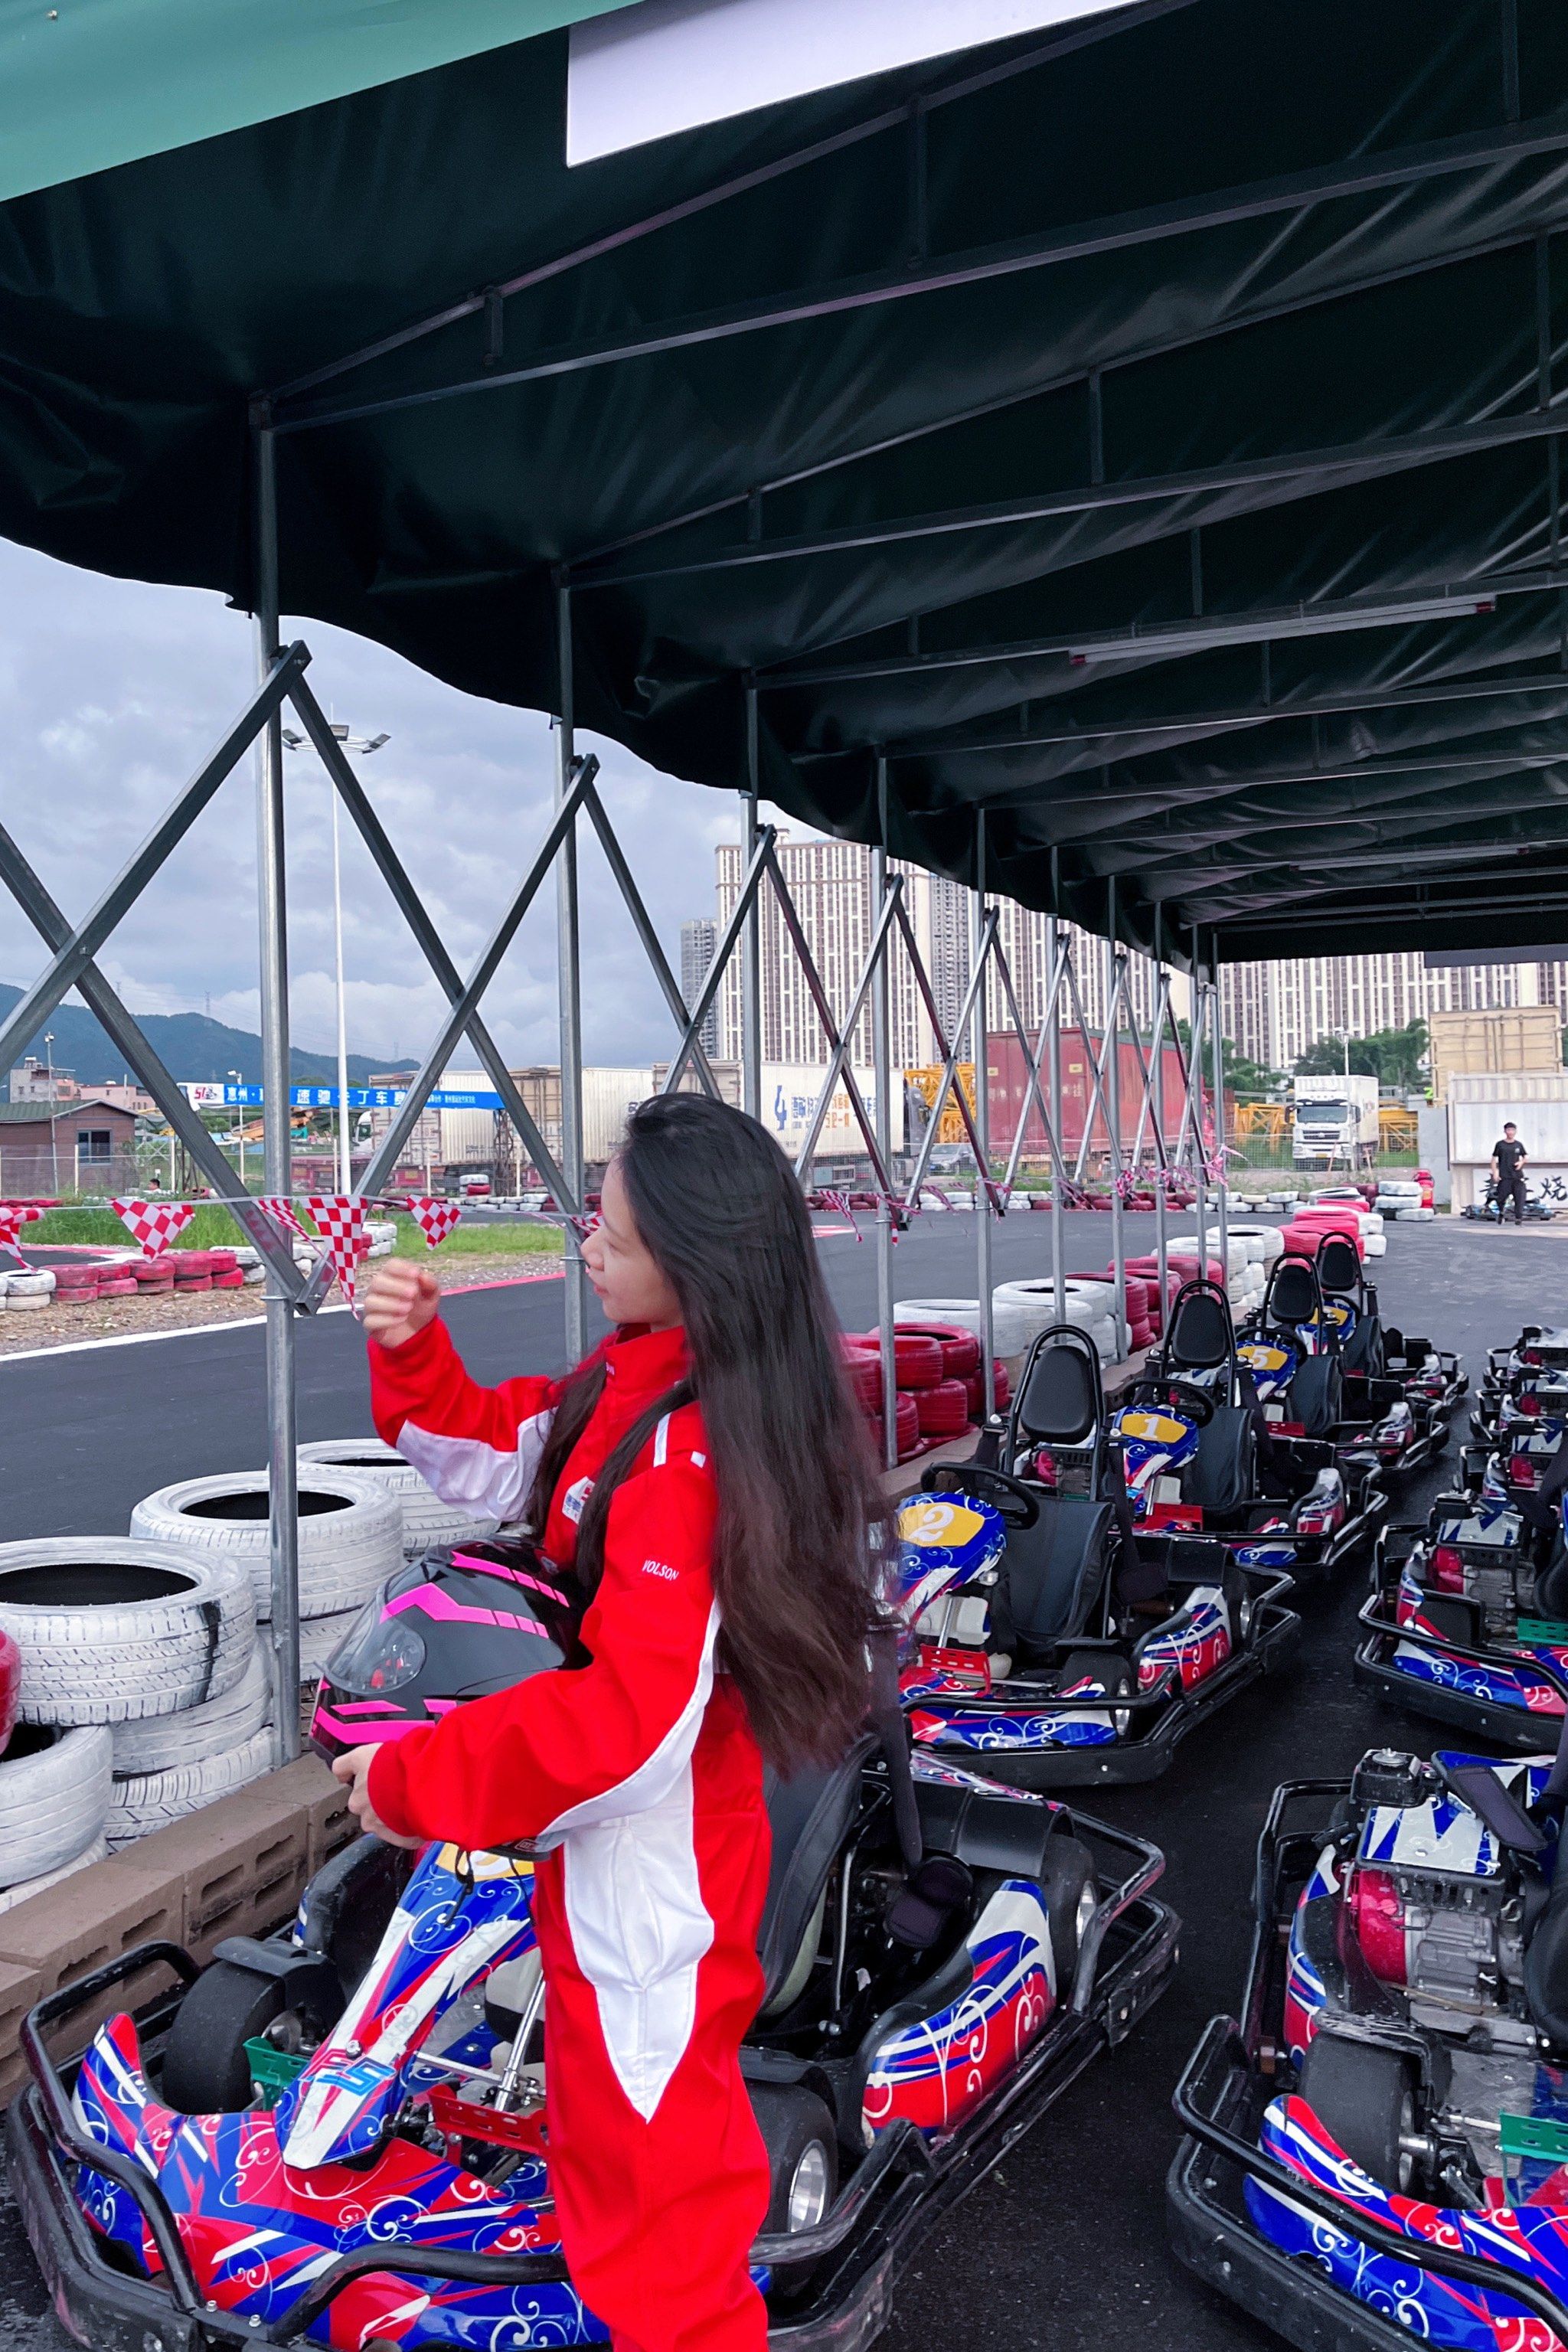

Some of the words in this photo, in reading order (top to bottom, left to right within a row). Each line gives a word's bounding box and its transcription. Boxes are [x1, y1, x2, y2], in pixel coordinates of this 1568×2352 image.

[1248, 1348, 1271, 1369] 5
[1139, 1416, 1159, 1439] 1
[909, 1505, 955, 1541] 2
[642, 1559, 680, 1581] VOLSON
